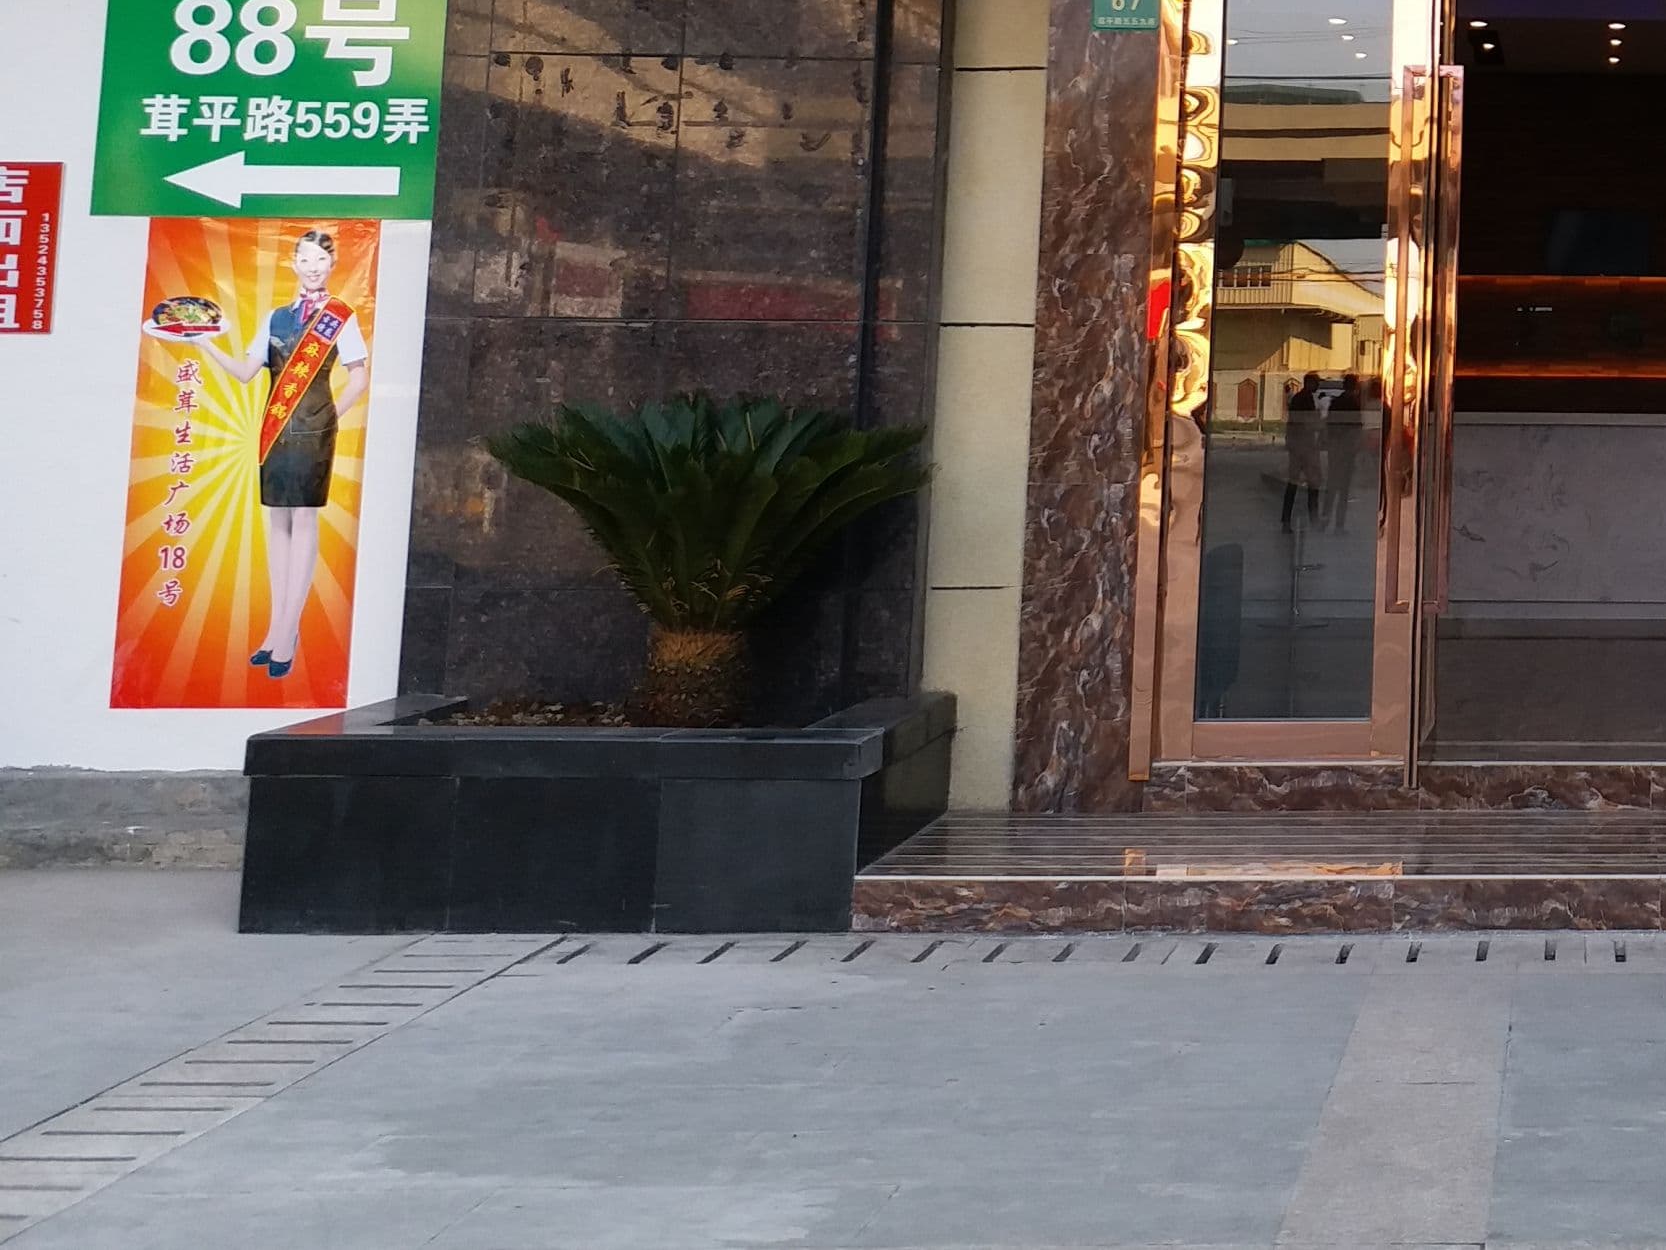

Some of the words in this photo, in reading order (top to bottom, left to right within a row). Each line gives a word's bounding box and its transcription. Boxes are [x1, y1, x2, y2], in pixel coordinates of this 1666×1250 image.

[139, 93, 431, 145] 茸平路559弄
[31, 212, 51, 330] 13524353758
[158, 359, 203, 607] 盛茸生活广场18号
